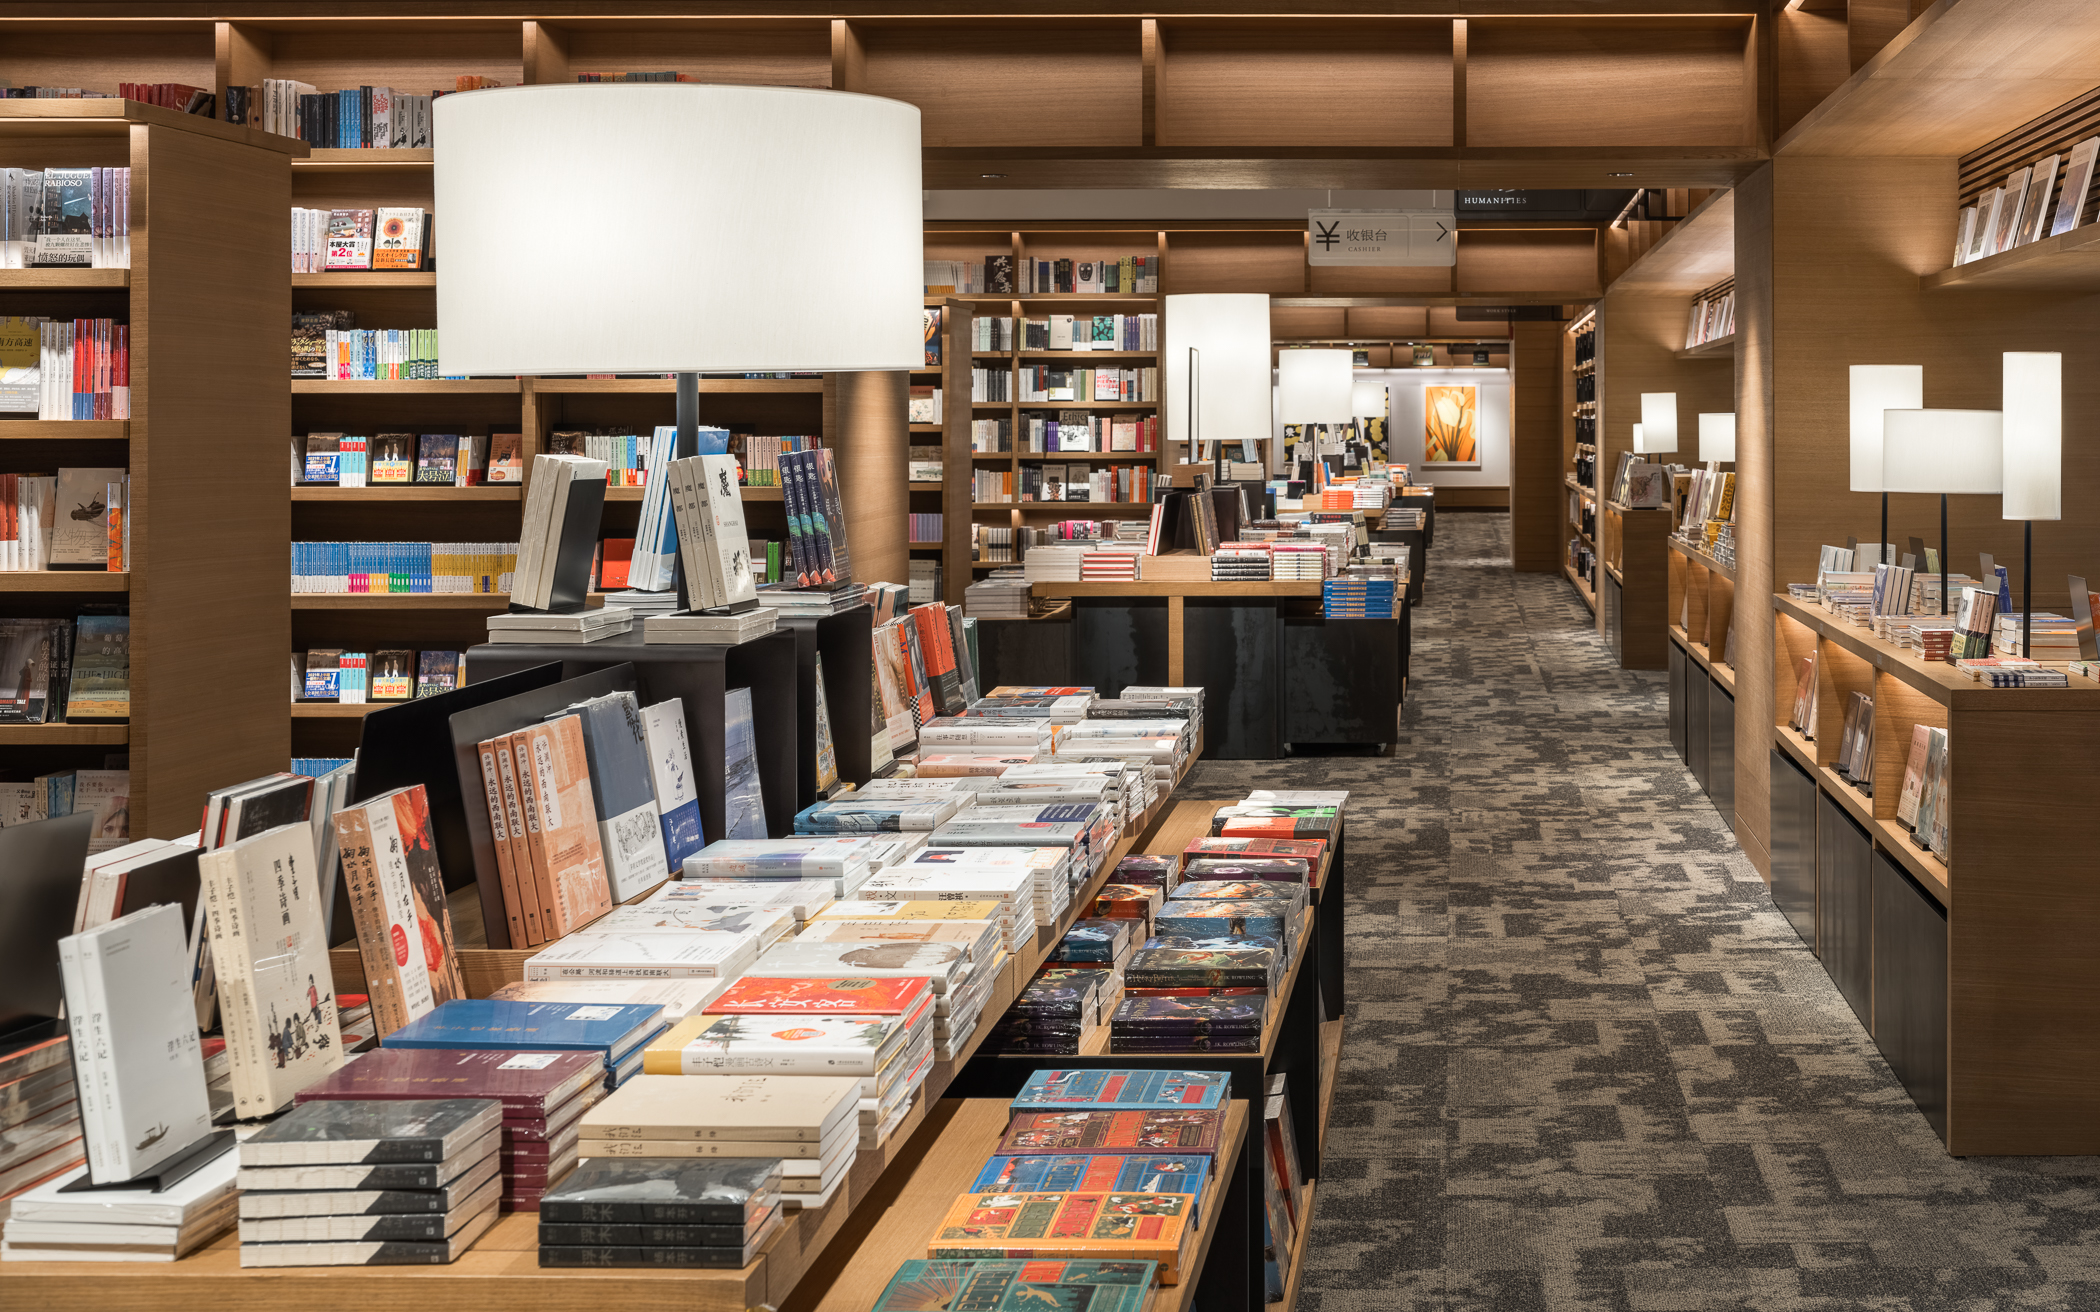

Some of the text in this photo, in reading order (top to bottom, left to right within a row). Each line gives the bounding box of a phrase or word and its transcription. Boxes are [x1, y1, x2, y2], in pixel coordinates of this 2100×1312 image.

[1464, 196, 1528, 205] HUMANITIES
[1346, 228, 1388, 243] 收银台
[38, 253, 85, 263] 愤怒的玩偶
[331, 247, 353, 258] 第2位
[1063, 411, 1088, 421] Ethics
[938, 892, 964, 901] 汪曾祺
[73, 1015, 90, 1062] 浮生六记
[91, 1012, 109, 1060] 浮生六记
[167, 1030, 197, 1053] 浮生六记
[581, 1203, 613, 1221] 浮木
[581, 1226, 613, 1244] 浮木
[581, 1249, 613, 1267] 浮木
